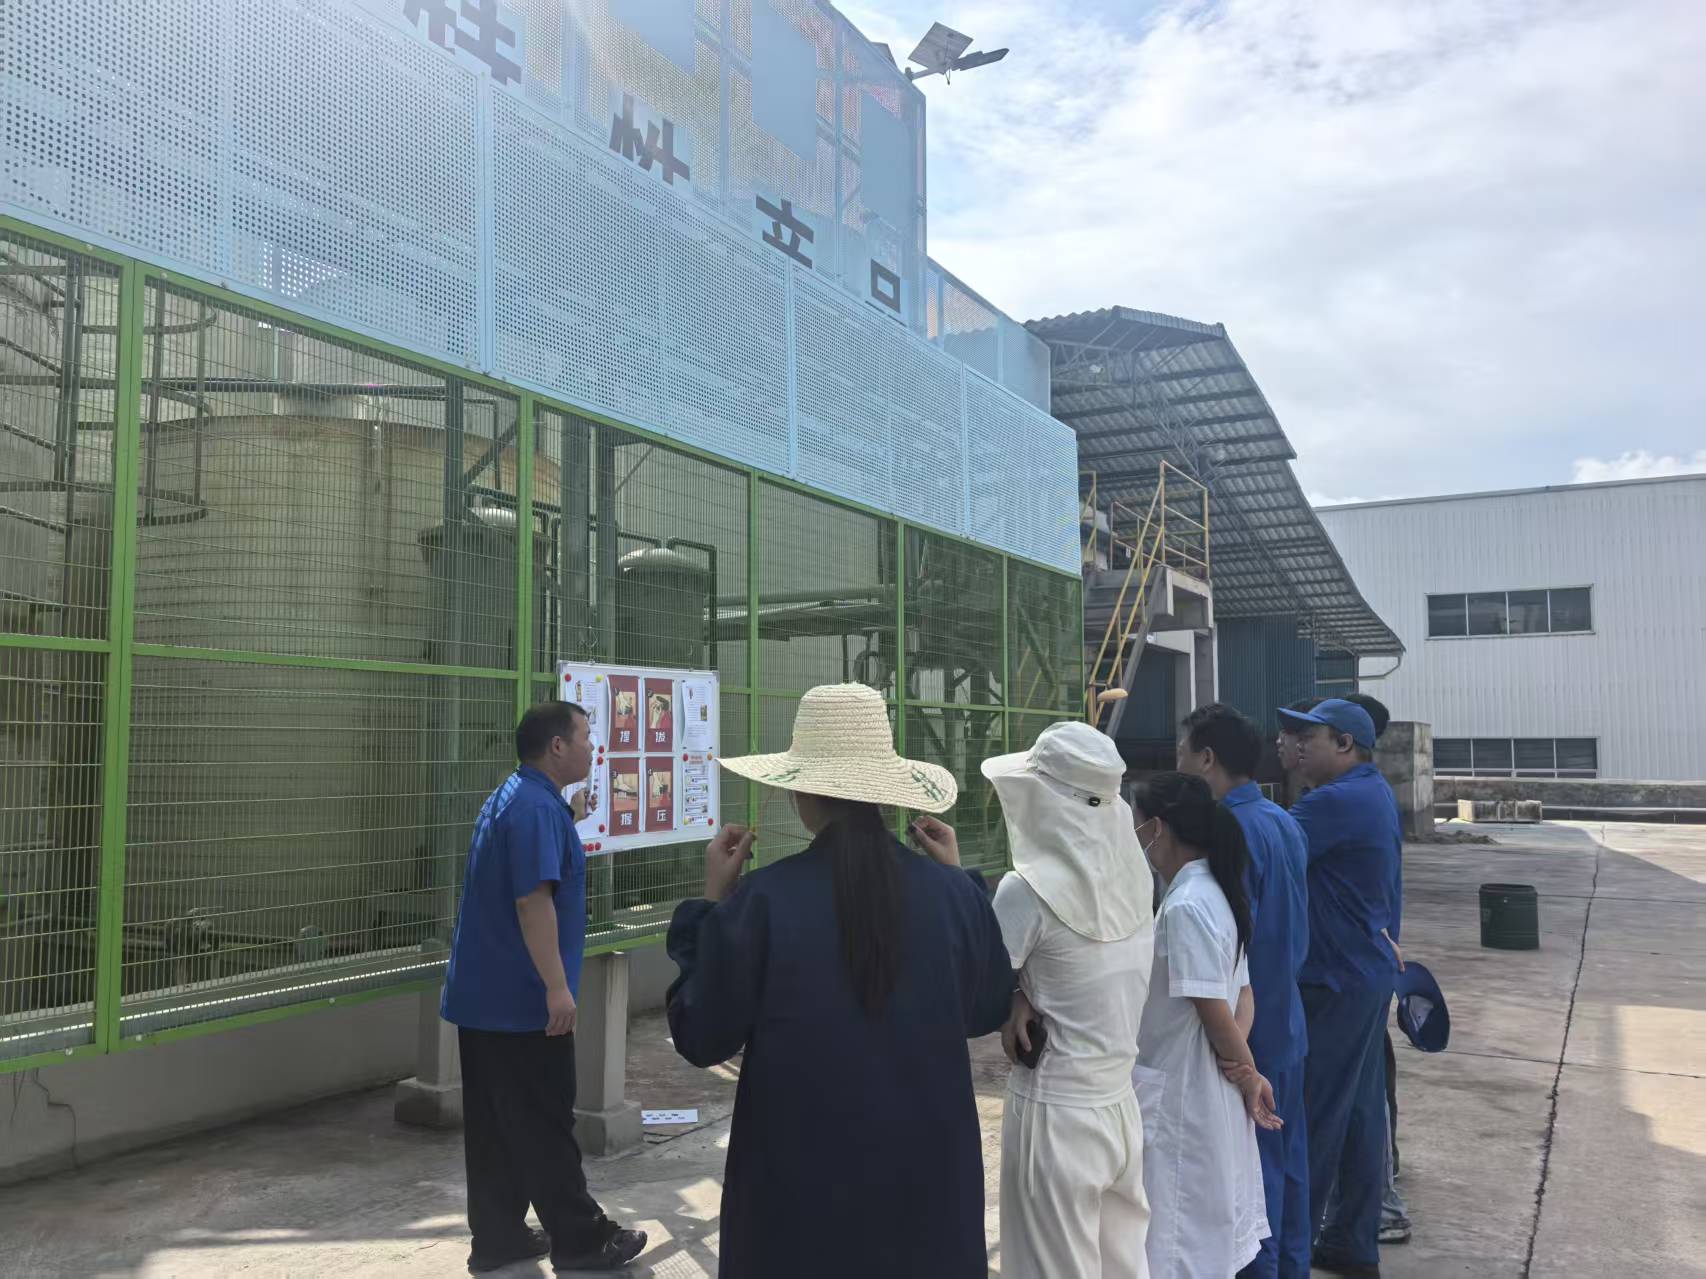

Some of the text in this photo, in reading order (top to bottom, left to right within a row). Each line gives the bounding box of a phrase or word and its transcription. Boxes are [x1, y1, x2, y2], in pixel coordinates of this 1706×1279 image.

[620, 730, 631, 743] 提
[655, 731, 666, 743] 拔
[656, 809, 667, 822] 压
